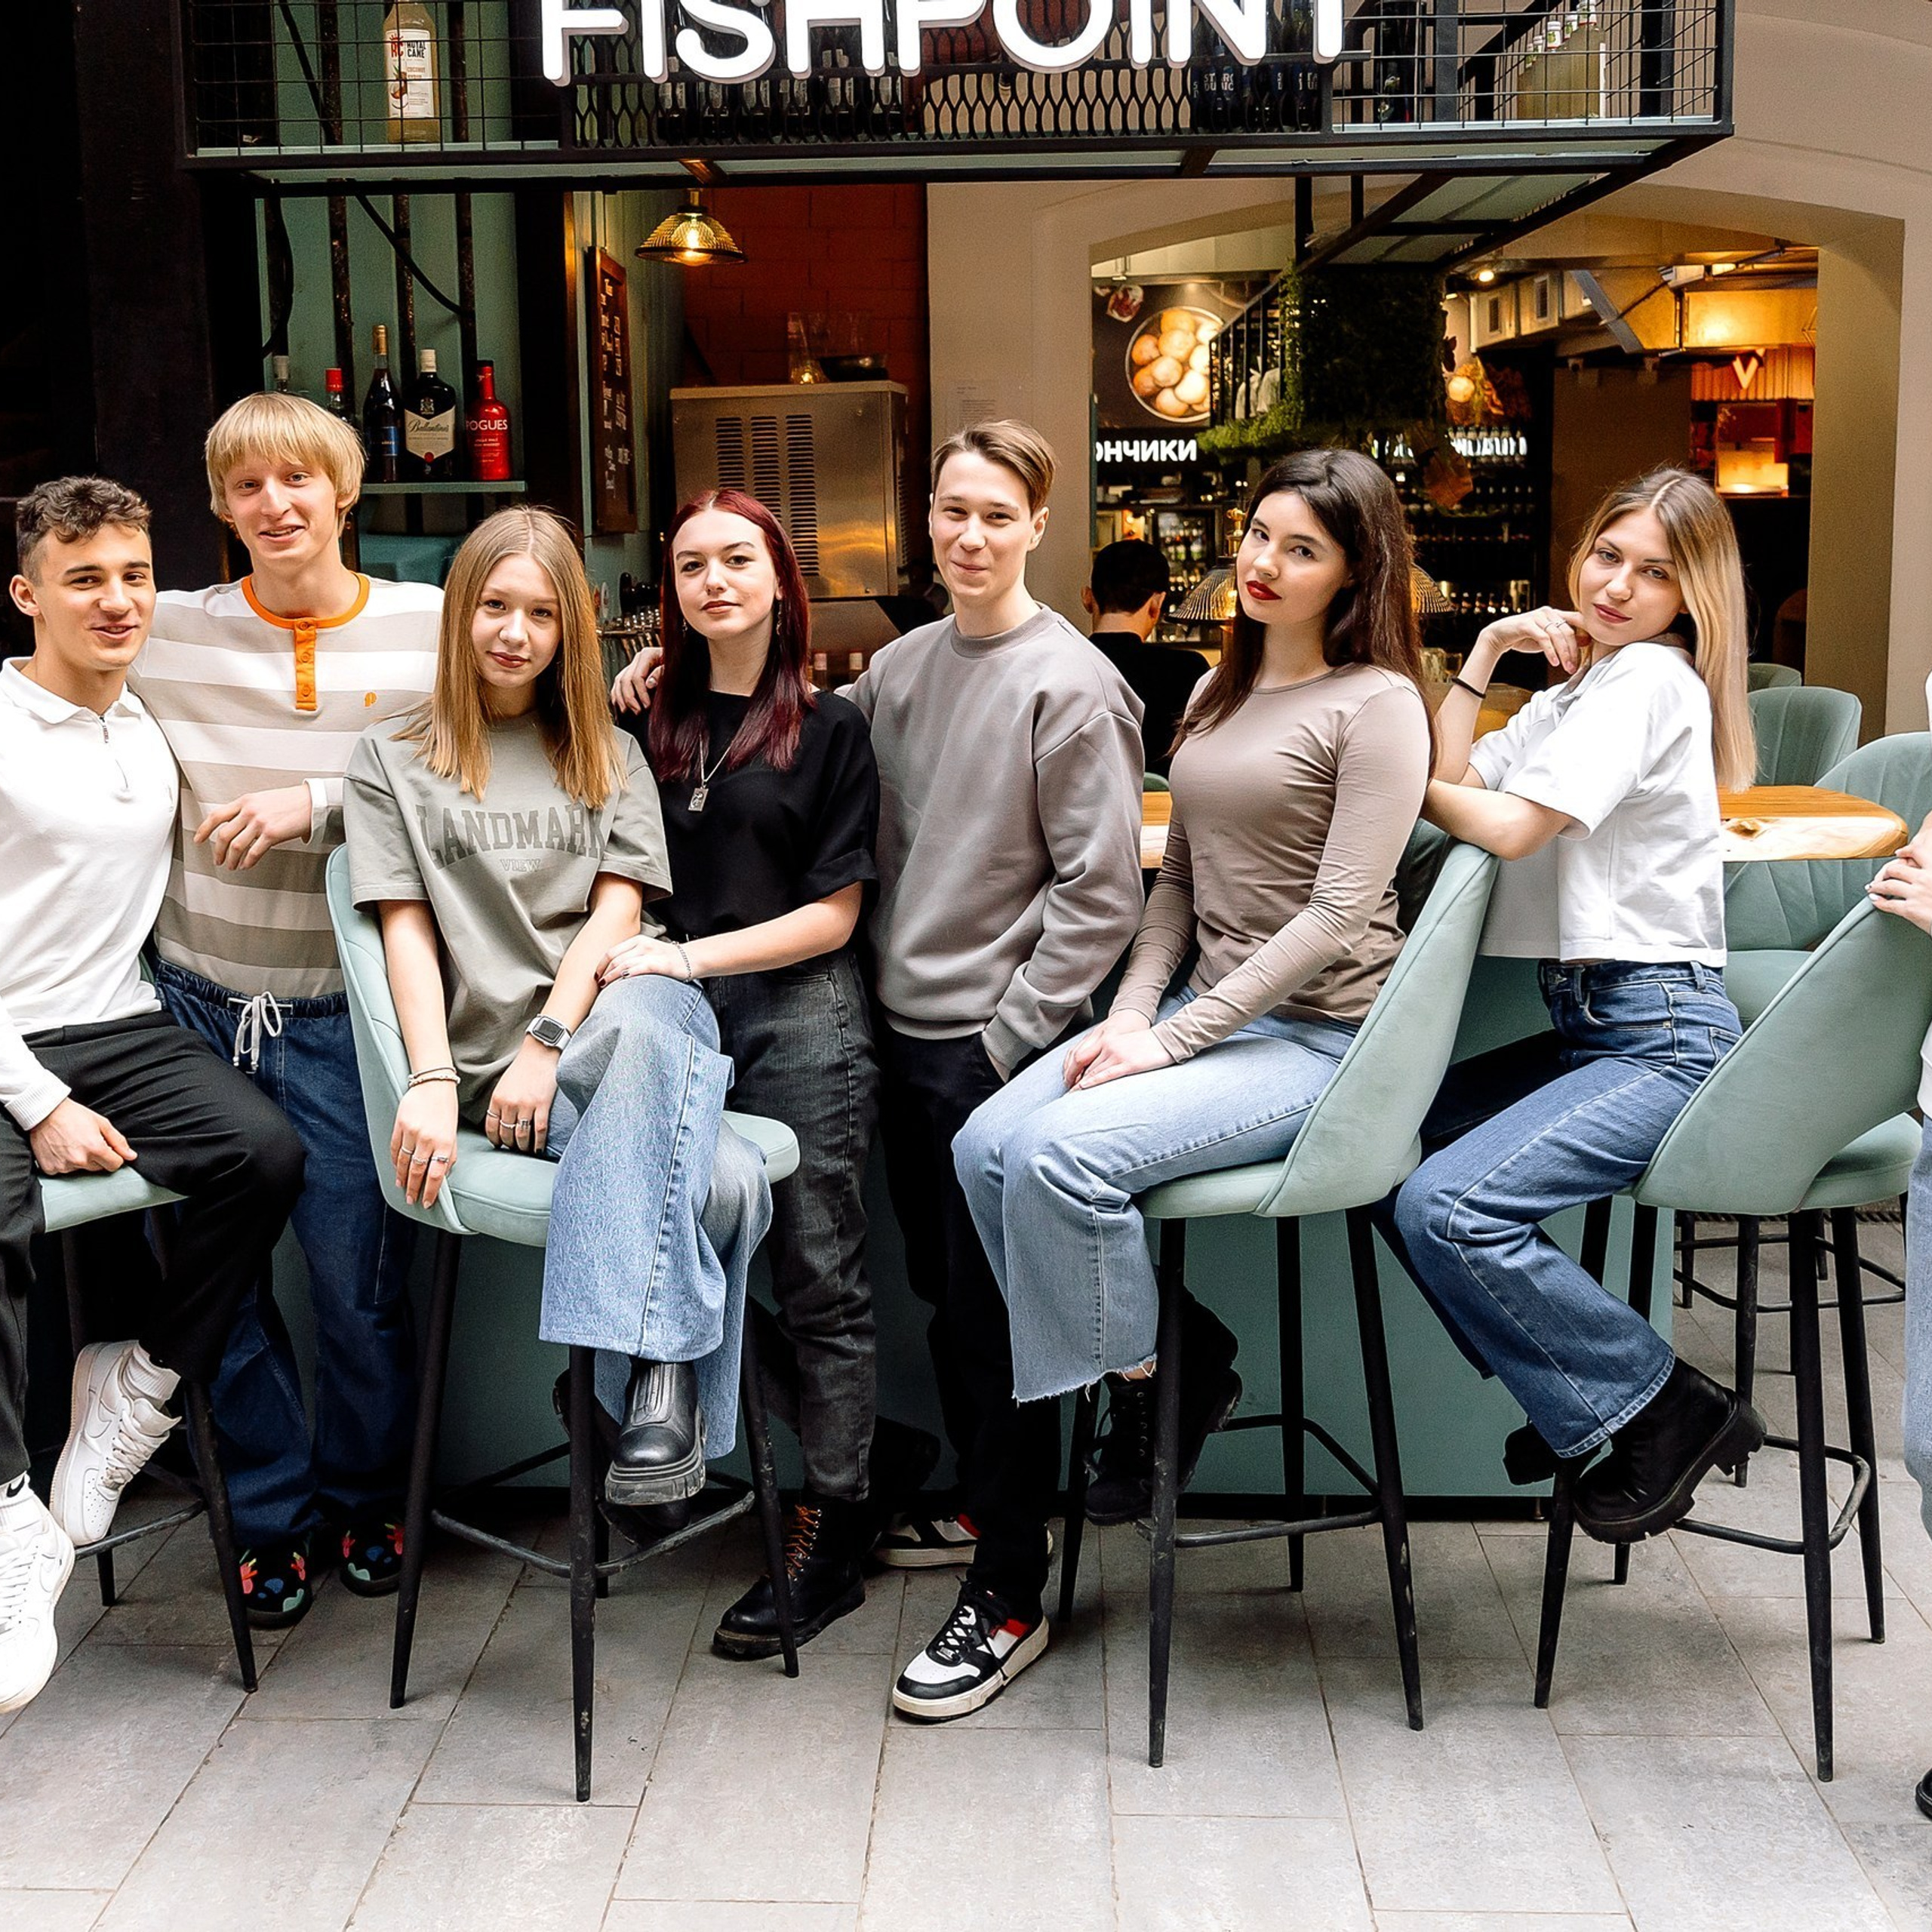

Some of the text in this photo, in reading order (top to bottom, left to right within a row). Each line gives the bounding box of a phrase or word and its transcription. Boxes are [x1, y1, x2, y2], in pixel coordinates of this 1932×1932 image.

[408, 48, 425, 58] CANE
[416, 803, 602, 866] LANDMARK
[499, 858, 540, 872] VIEW
